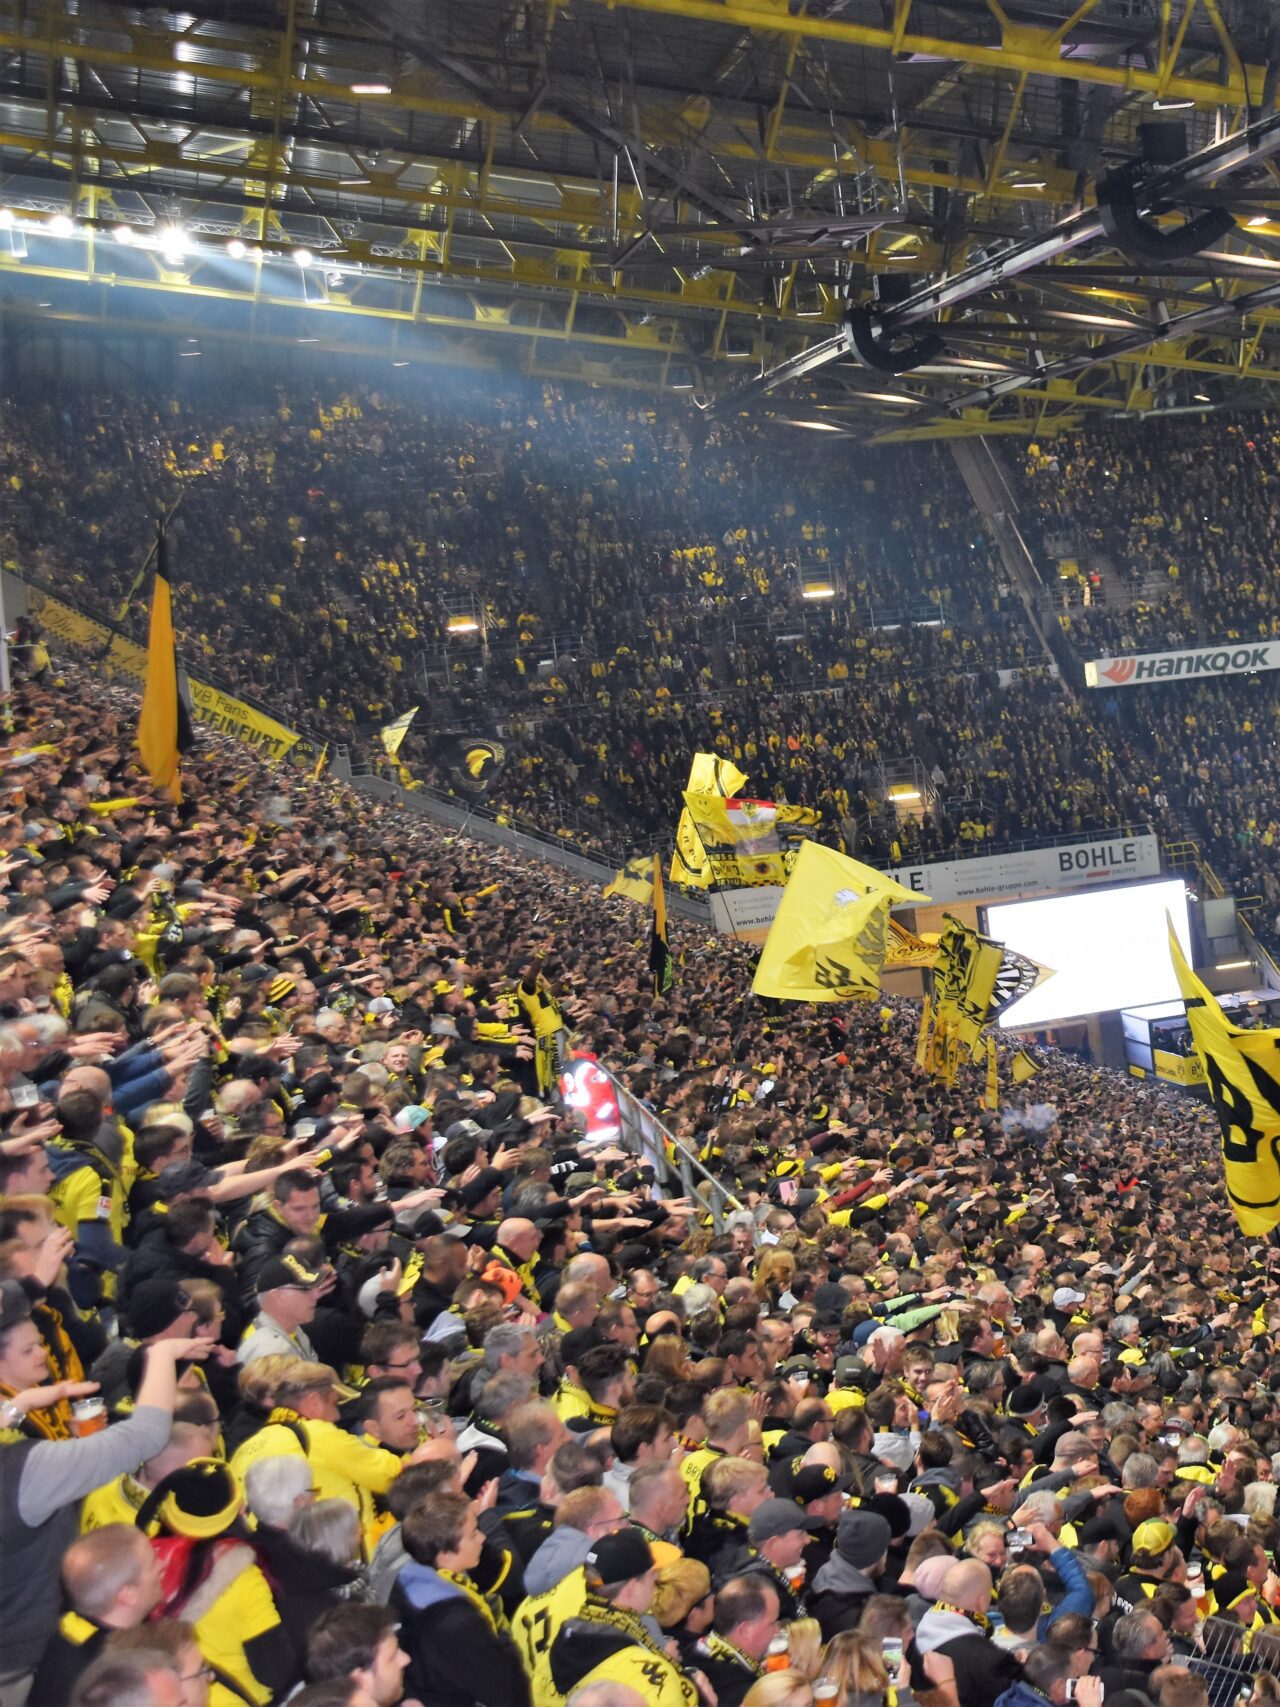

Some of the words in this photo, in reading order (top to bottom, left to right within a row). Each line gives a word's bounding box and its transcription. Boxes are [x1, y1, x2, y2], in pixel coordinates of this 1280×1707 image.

[1134, 647, 1270, 680] HANKOOK
[215, 695, 249, 720] Fans
[192, 703, 285, 754] TEINFURT
[1058, 842, 1138, 873] BOHLE
[956, 878, 1039, 898] www.bohle-gruppe.com
